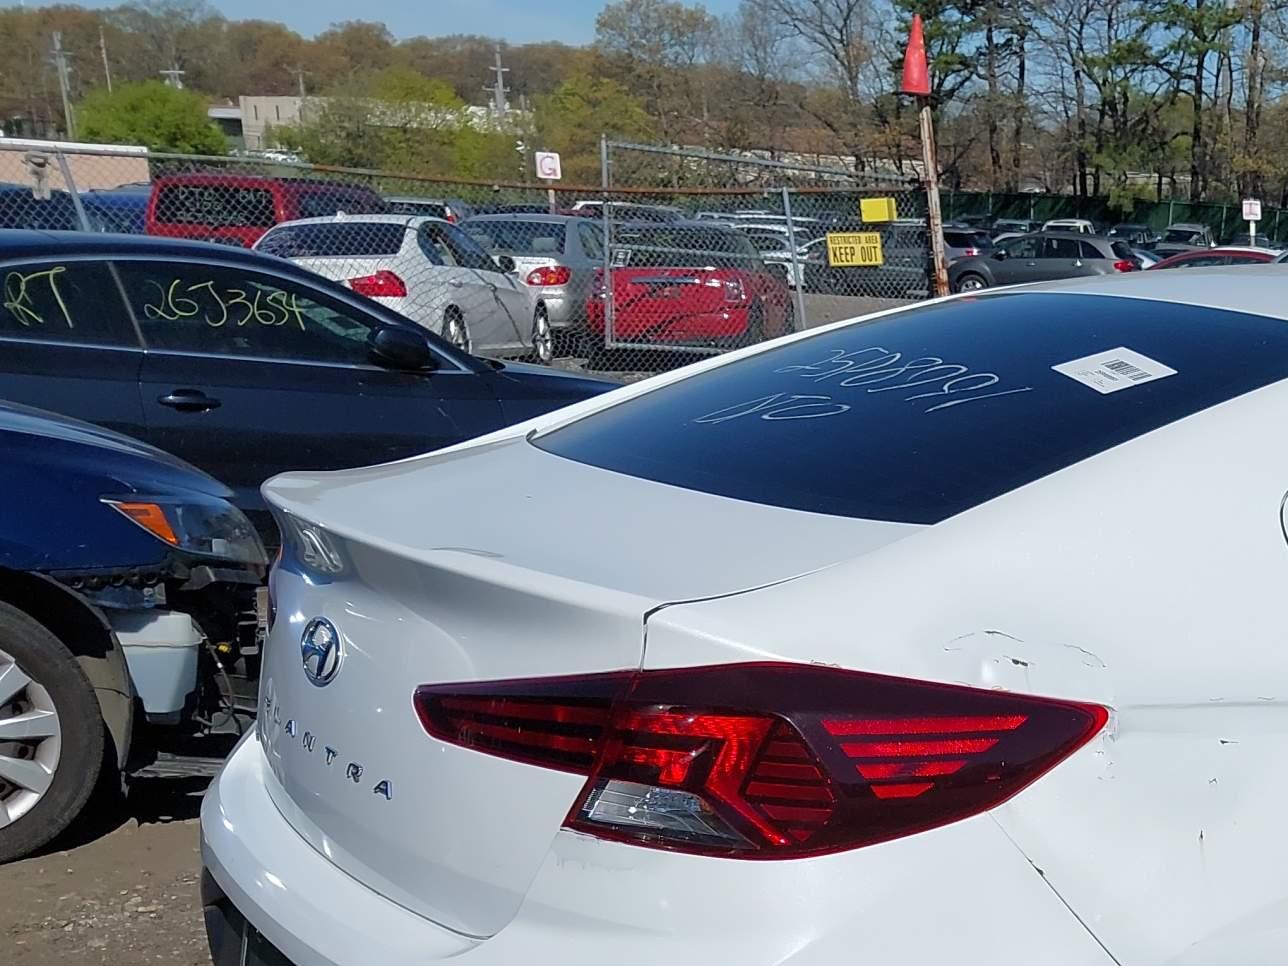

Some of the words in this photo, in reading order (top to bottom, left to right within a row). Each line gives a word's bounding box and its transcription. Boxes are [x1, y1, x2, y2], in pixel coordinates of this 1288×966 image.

[540, 155, 558, 177] G
[829, 235, 861, 245] RESTRICTED
[864, 235, 879, 244] AREA
[831, 246, 856, 263] KEEP
[860, 245, 879, 262] OUT
